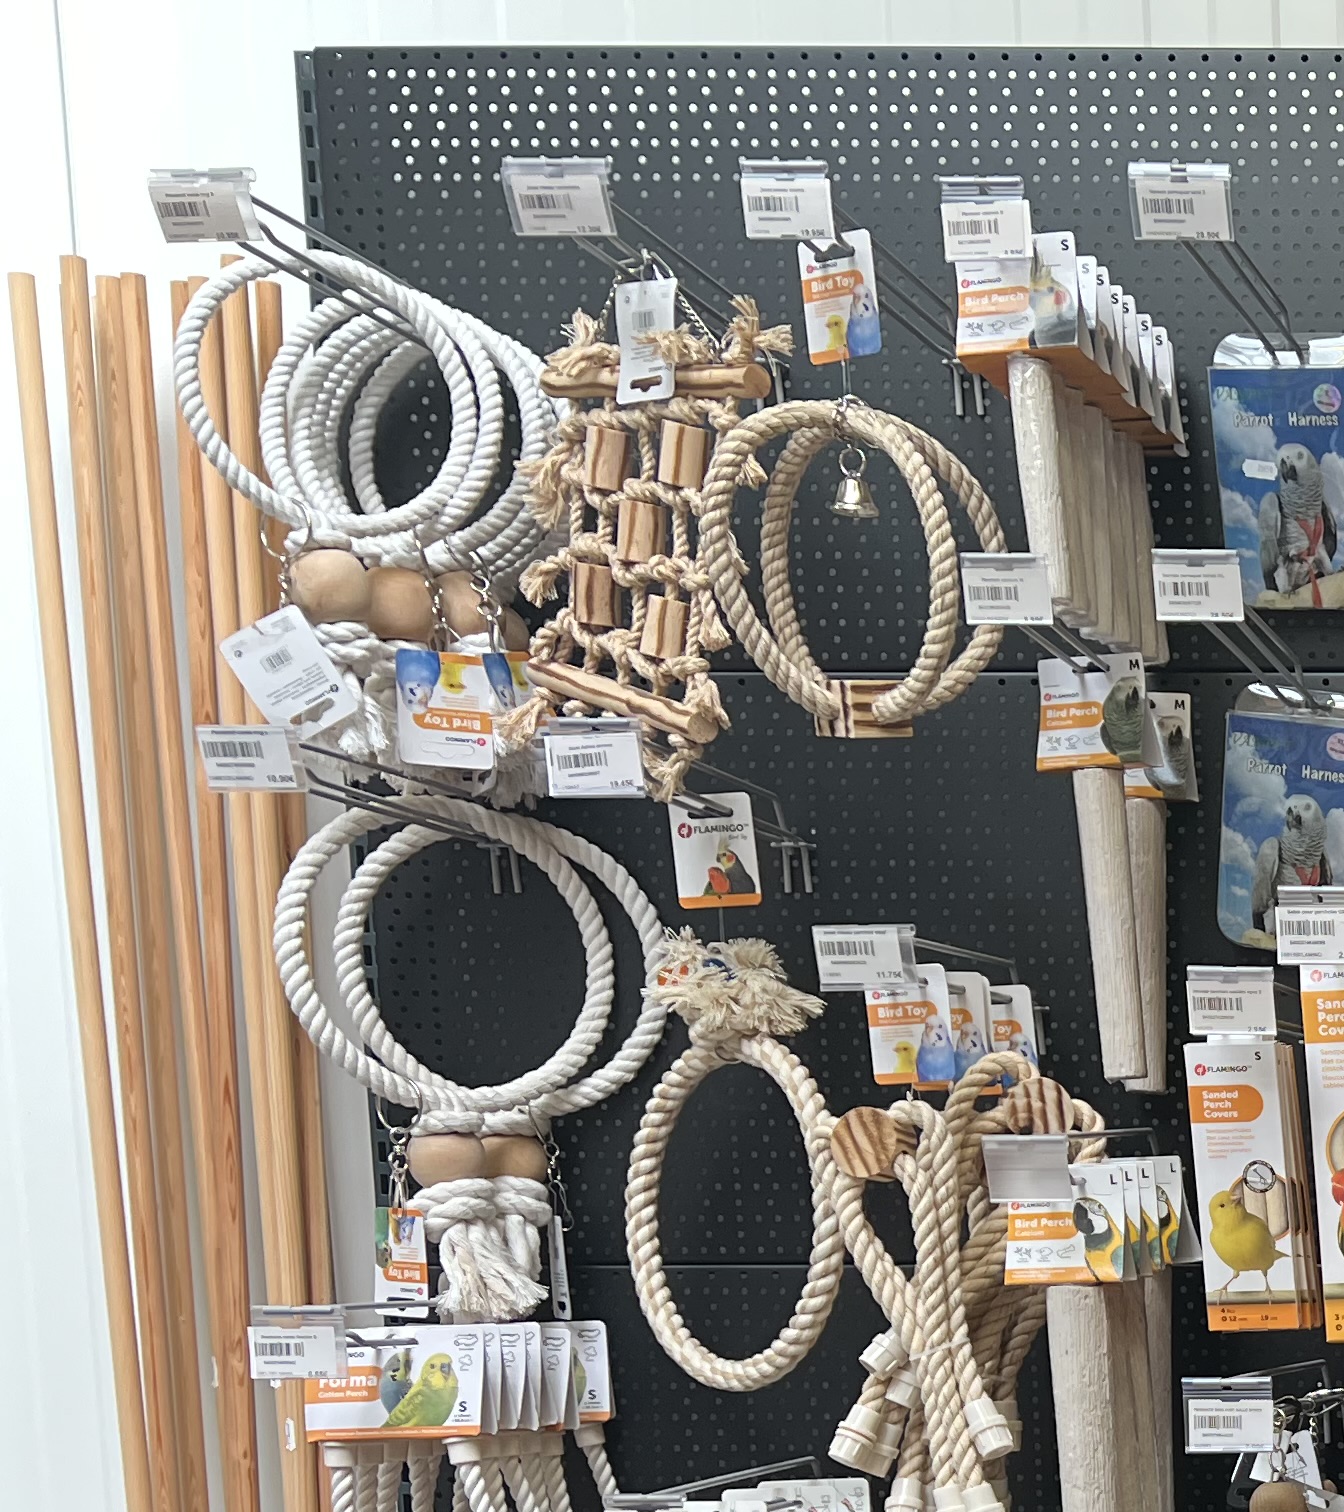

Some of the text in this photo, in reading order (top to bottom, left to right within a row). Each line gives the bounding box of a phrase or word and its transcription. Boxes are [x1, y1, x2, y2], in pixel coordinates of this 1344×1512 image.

[1061, 239, 1069, 250] S
[1082, 263, 1089, 273] S
[811, 275, 855, 292] Bird Toy
[1096, 274, 1104, 285] S
[965, 295, 988, 306] Bird
[1111, 292, 1118, 304] S
[1121, 302, 1129, 312] S
[1141, 321, 1148, 331] S
[1155, 335, 1163, 346] S
[1234, 412, 1339, 427] Parrot Harness
[1128, 659, 1140, 670] M
[1174, 699, 1185, 710] M
[1046, 706, 1098, 719] Bird Perch
[423, 714, 481, 730] Bird Toy
[1247, 758, 1288, 776] Parrot
[693, 823, 744, 834] FLAMINGO
[877, 1005, 928, 1018] Bird Toy
[1254, 1051, 1262, 1061] S
[1207, 1065, 1248, 1074] FLAMINGO
[1202, 1091, 1238, 1099] Sanded
[1203, 1099, 1232, 1109] Perch
[1203, 1110, 1239, 1119] Covers
[1141, 1168, 1149, 1179] L
[1170, 1163, 1176, 1173] L
[1109, 1174, 1117, 1185] L
[1125, 1171, 1133, 1182] L
[1015, 1217, 1073, 1229] Bird Perch
[588, 1390, 596, 1400] S
[458, 1400, 467, 1412] S
